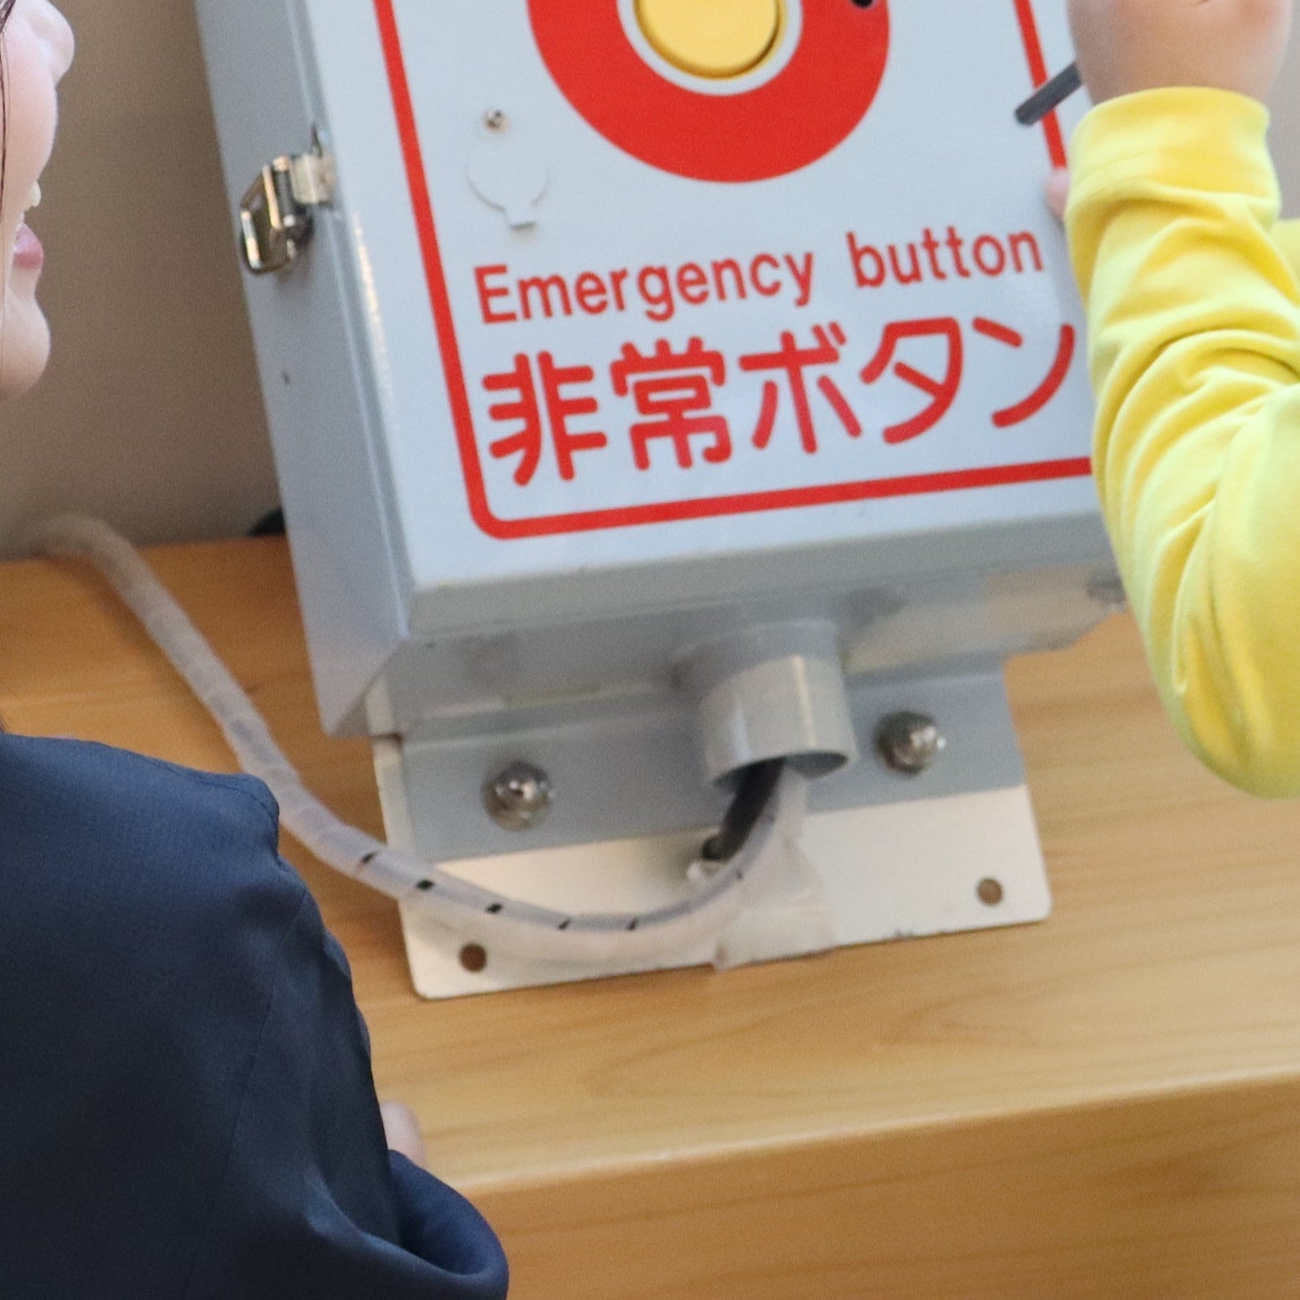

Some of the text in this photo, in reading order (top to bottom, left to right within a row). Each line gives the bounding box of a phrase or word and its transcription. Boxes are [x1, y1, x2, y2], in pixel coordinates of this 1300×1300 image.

[474, 227, 1042, 324] Emergency button
[481, 316, 1077, 488] 非常ボタン
